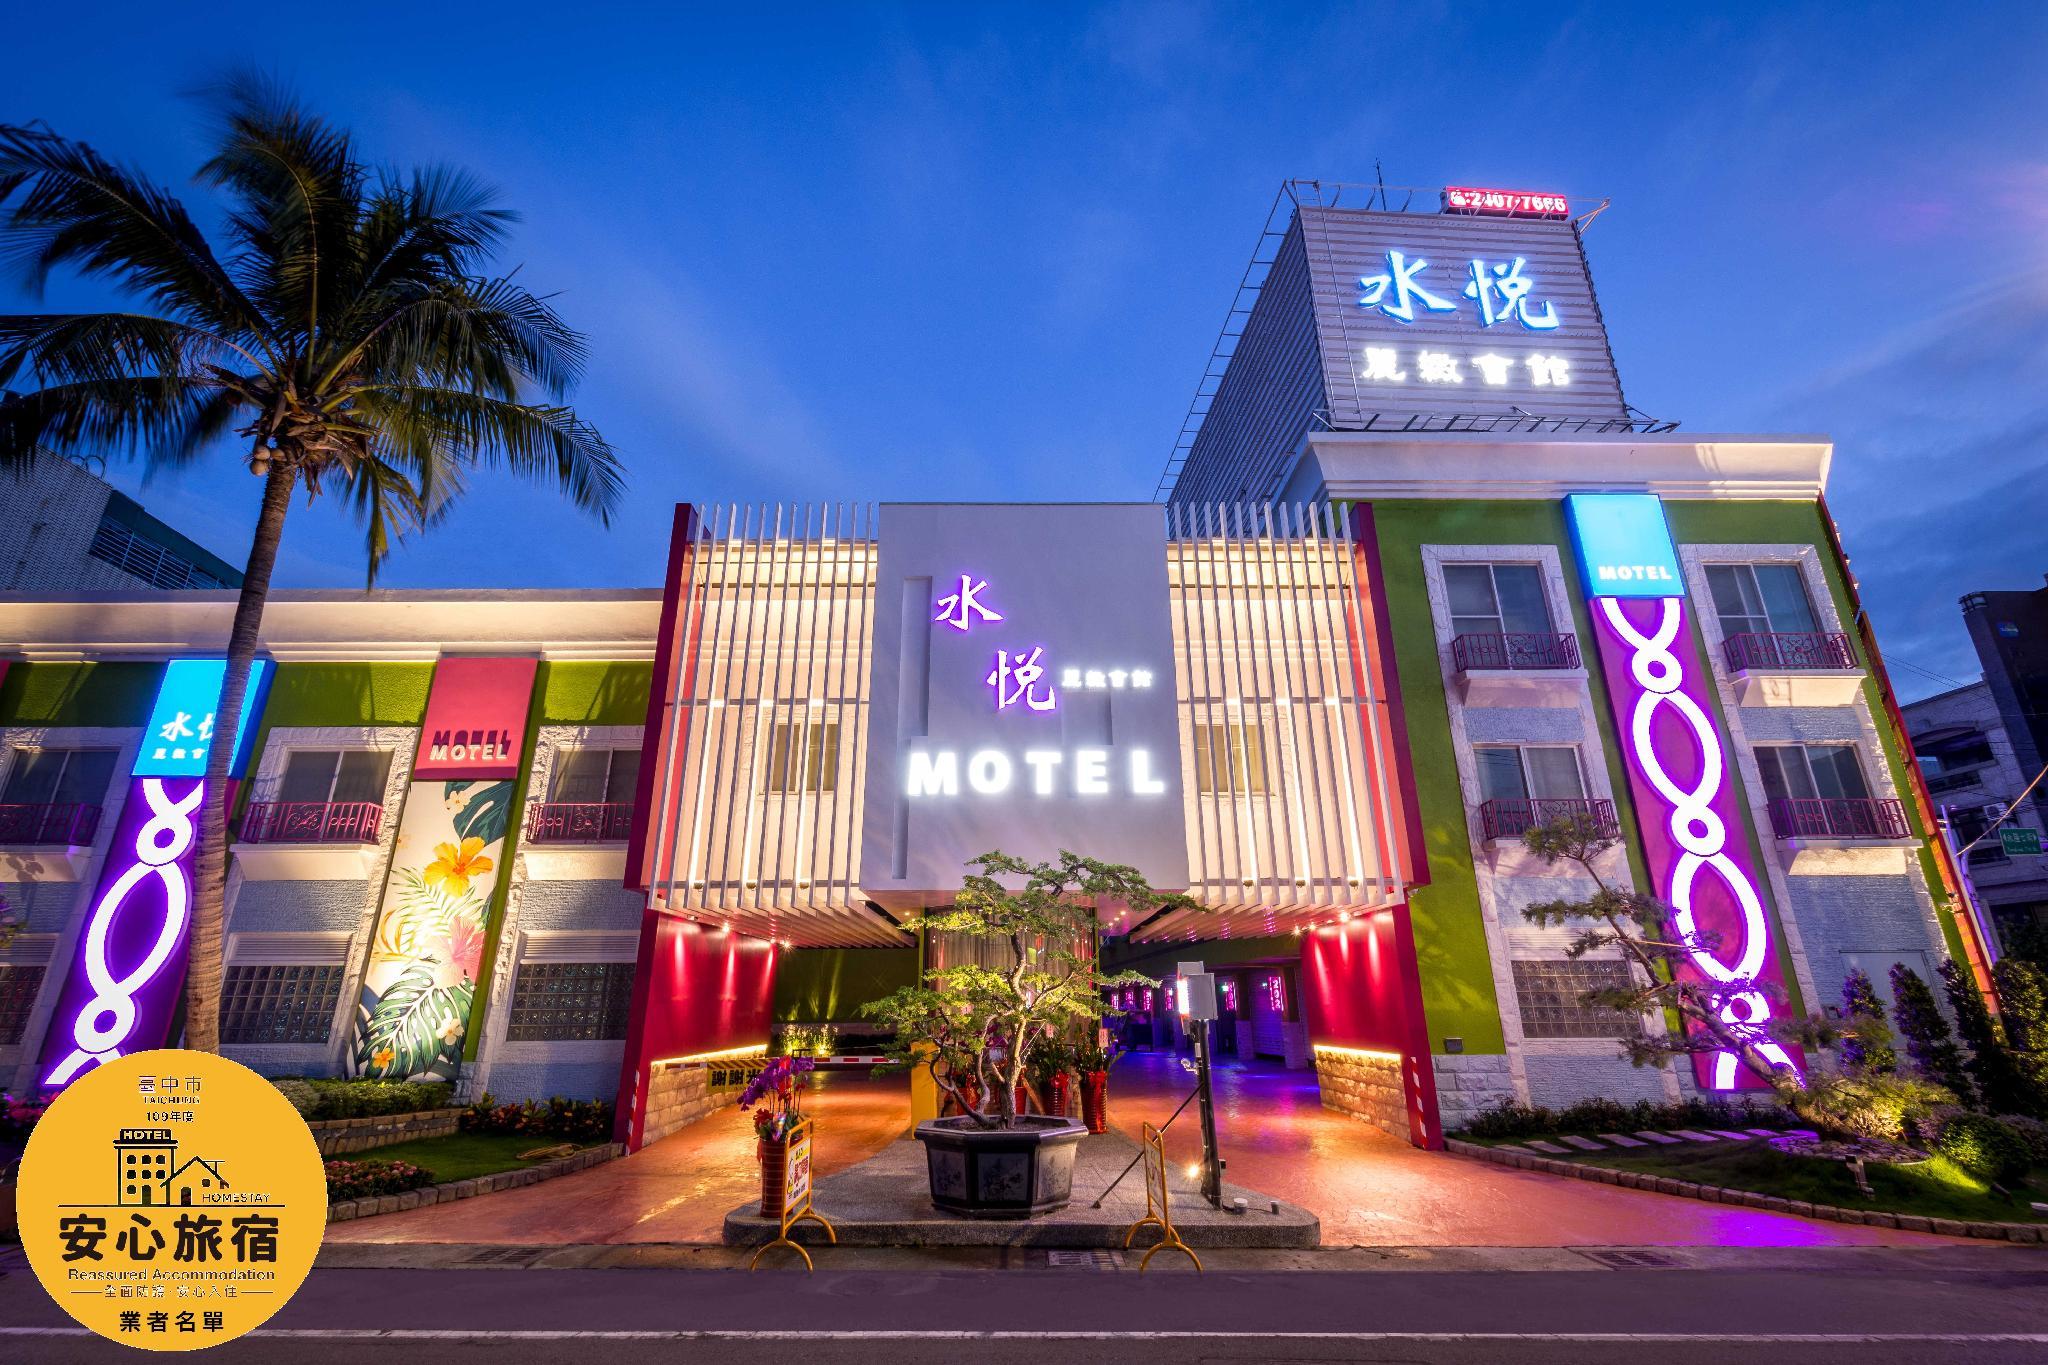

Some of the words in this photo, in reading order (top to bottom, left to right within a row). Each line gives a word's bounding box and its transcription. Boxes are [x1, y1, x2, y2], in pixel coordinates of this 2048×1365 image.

[1598, 565, 1673, 580] MOTEL
[429, 743, 508, 761] MOTEL
[907, 749, 1165, 797] MOTEL
